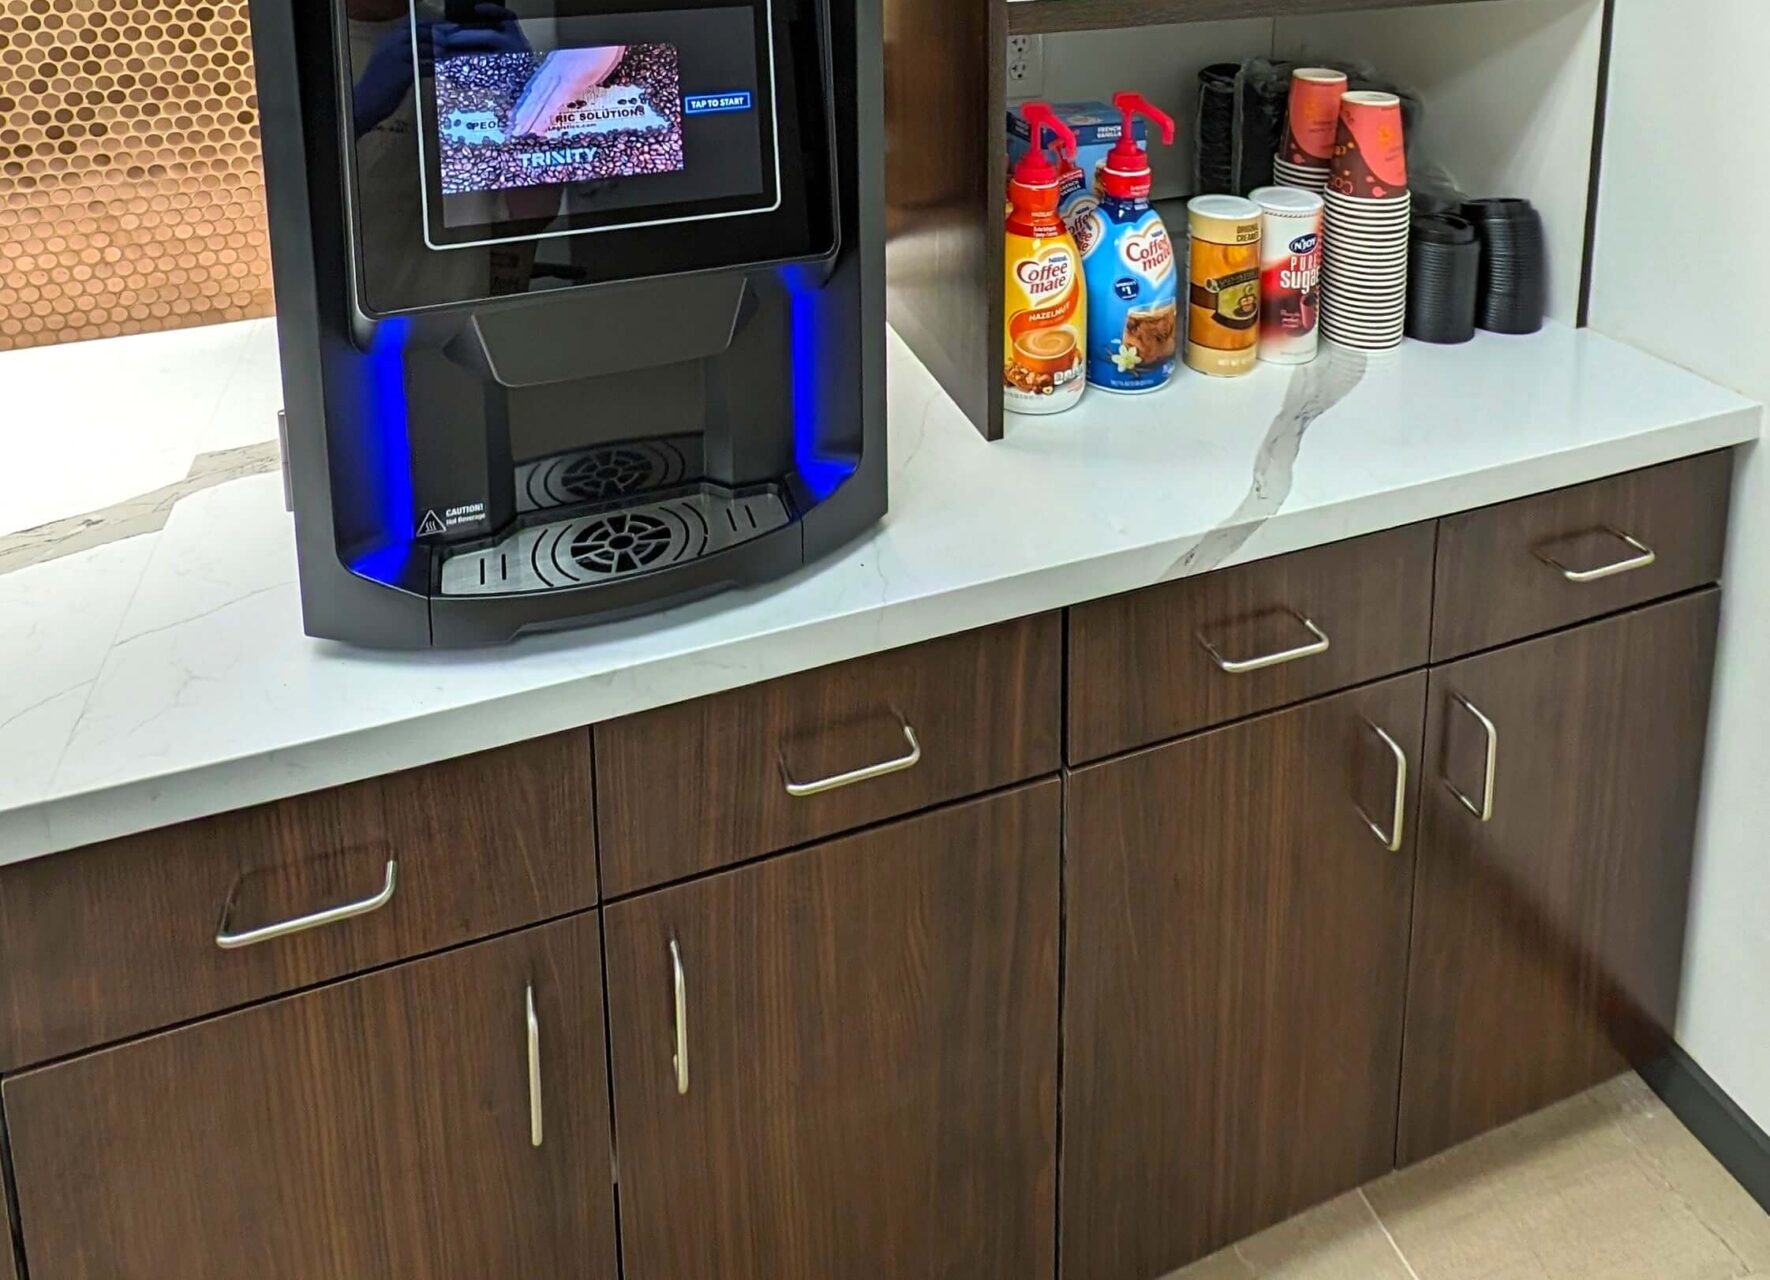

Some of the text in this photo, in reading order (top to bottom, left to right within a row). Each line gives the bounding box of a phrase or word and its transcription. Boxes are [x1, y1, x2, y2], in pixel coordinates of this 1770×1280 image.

[690, 97, 744, 109] TAP TO START
[519, 147, 598, 169] TRINITY
[1017, 260, 1068, 284] Coffee
[1030, 276, 1066, 295] mate
[1029, 300, 1071, 322] HAZELNUT
[445, 503, 484, 517] CAUTION!
[458, 513, 486, 523] Beverage
